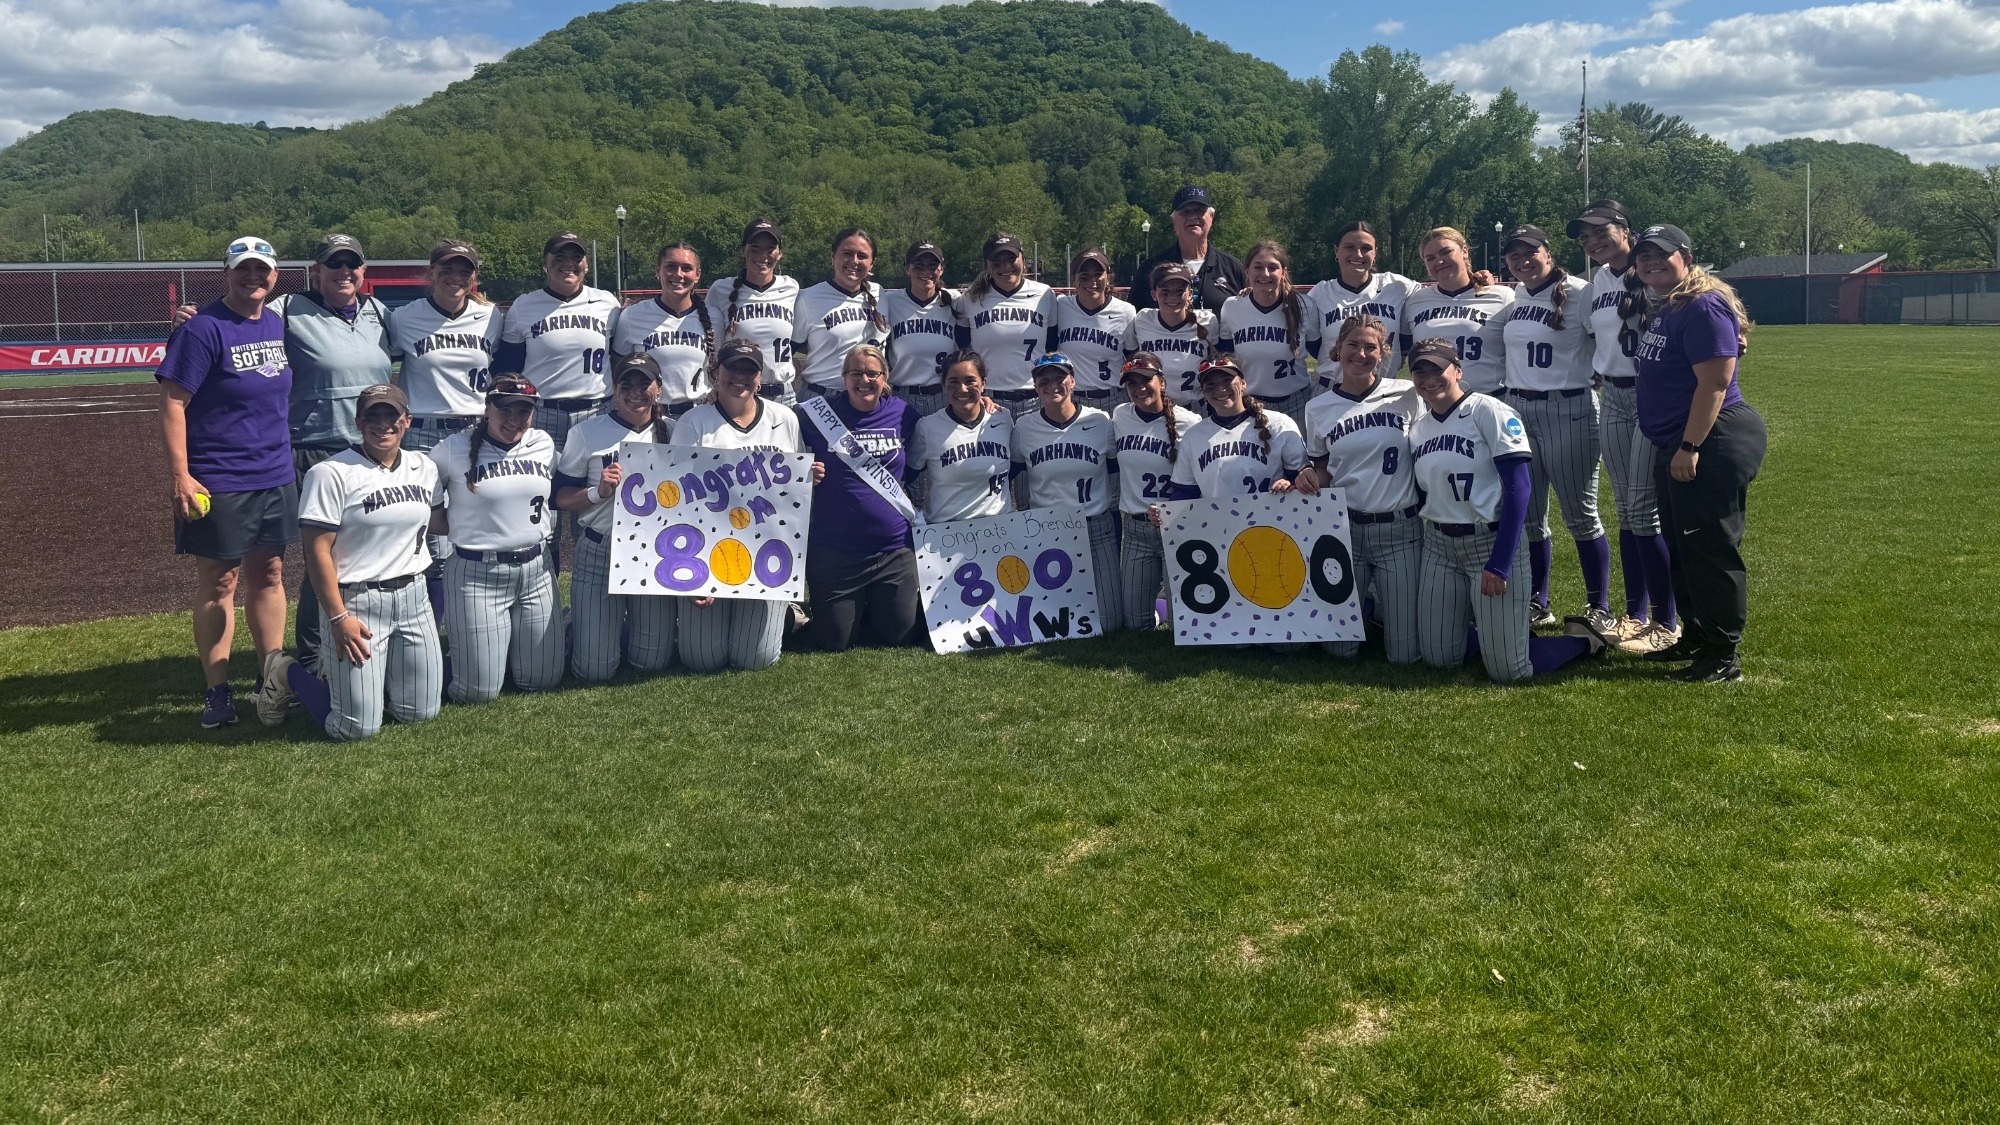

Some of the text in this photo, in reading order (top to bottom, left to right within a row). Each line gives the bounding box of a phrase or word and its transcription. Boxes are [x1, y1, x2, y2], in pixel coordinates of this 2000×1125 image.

[974, 308, 1043, 329] WARHAWKS
[1325, 303, 1395, 327] WARHAWKS
[1414, 306, 1487, 327] WARHAWKS
[893, 319, 953, 340] WARHAWKS
[1060, 327, 1119, 351] WARHAWKS
[31, 346, 166, 365] CARDINA
[583, 348, 605, 374] 18
[773, 338, 791, 363] 12
[1023, 339, 1038, 361] 7
[1141, 339, 1205, 358] WARHAWKS
[1456, 336, 1483, 361] 13
[1527, 341, 1553, 368] 10
[468, 368, 488, 392] 16
[1098, 361, 1111, 381] 5
[810, 398, 841, 431] HAPPY
[1326, 412, 1404, 446] WARHAWKS
[1030, 442, 1099, 467] WARHAWKS
[1198, 441, 1268, 472] WARHAWKS
[1382, 447, 1399, 475] 8
[1447, 473, 1475, 501] 17
[529, 495, 545, 525] 3
[922, 511, 1086, 560] Congrats Brenda
[991, 541, 1016, 554] on
